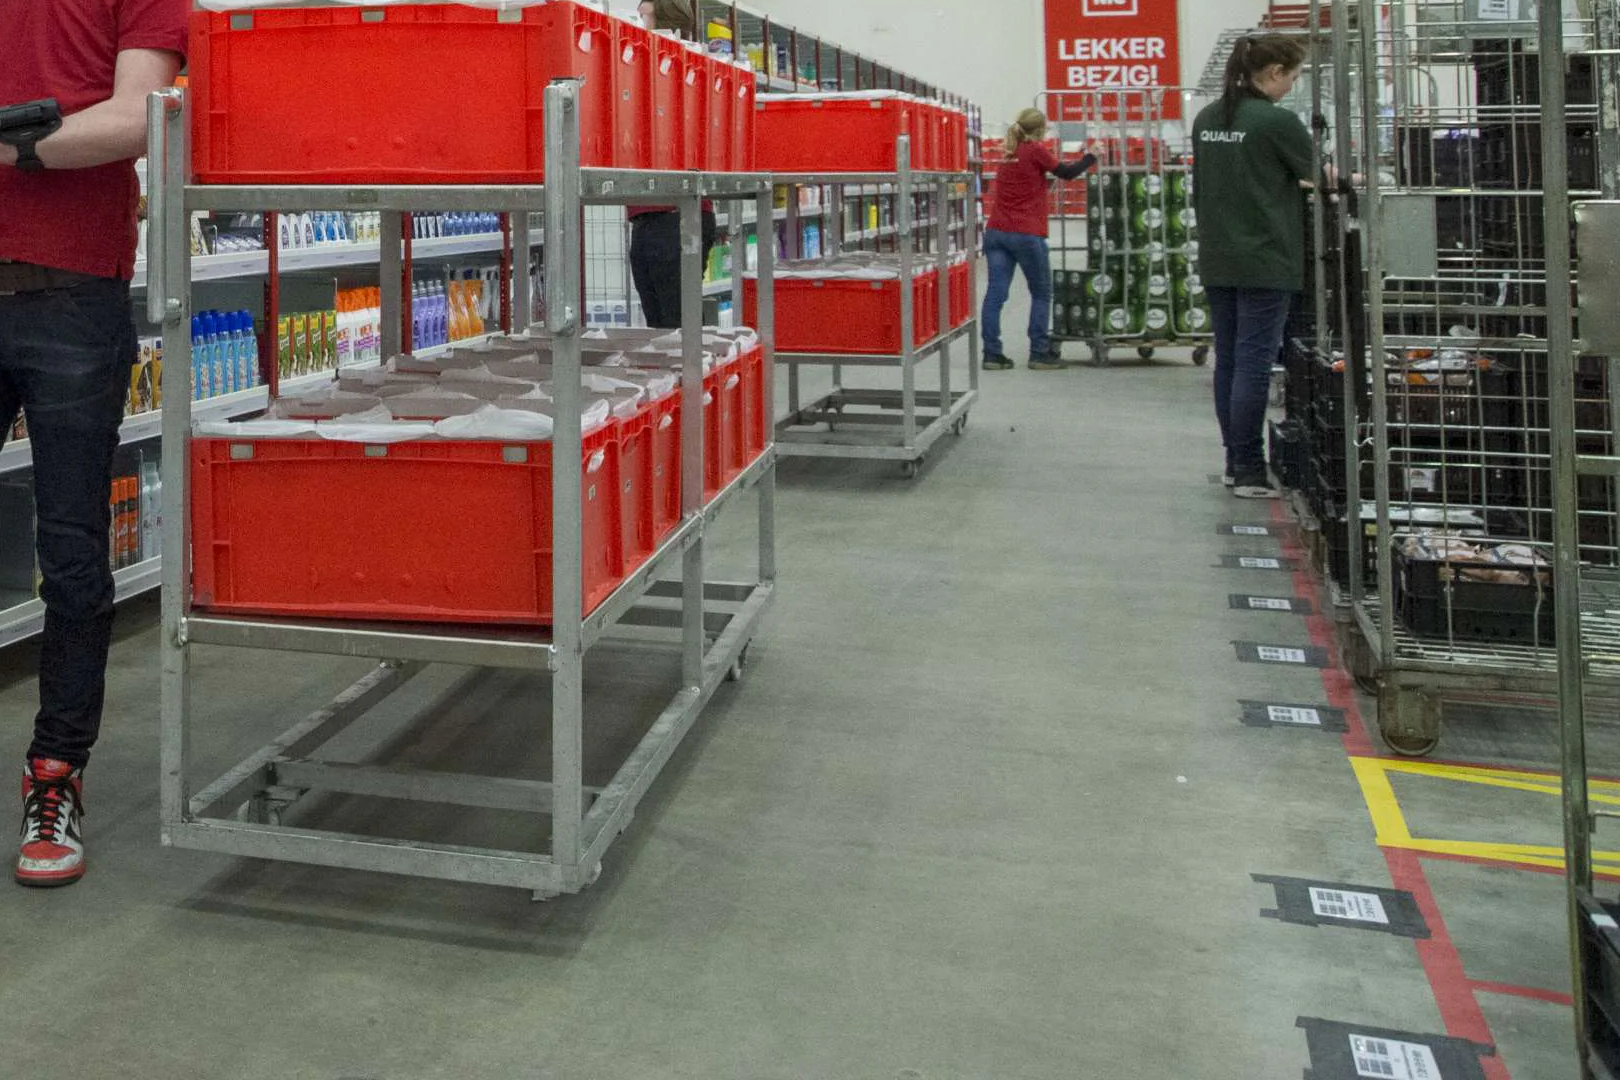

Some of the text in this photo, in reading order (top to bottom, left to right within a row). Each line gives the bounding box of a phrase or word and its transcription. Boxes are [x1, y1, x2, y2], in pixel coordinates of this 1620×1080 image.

[1058, 37, 1166, 60] LEKKER
[1067, 65, 1158, 87] BEZIG!
[1200, 130, 1246, 142] QUALITY
